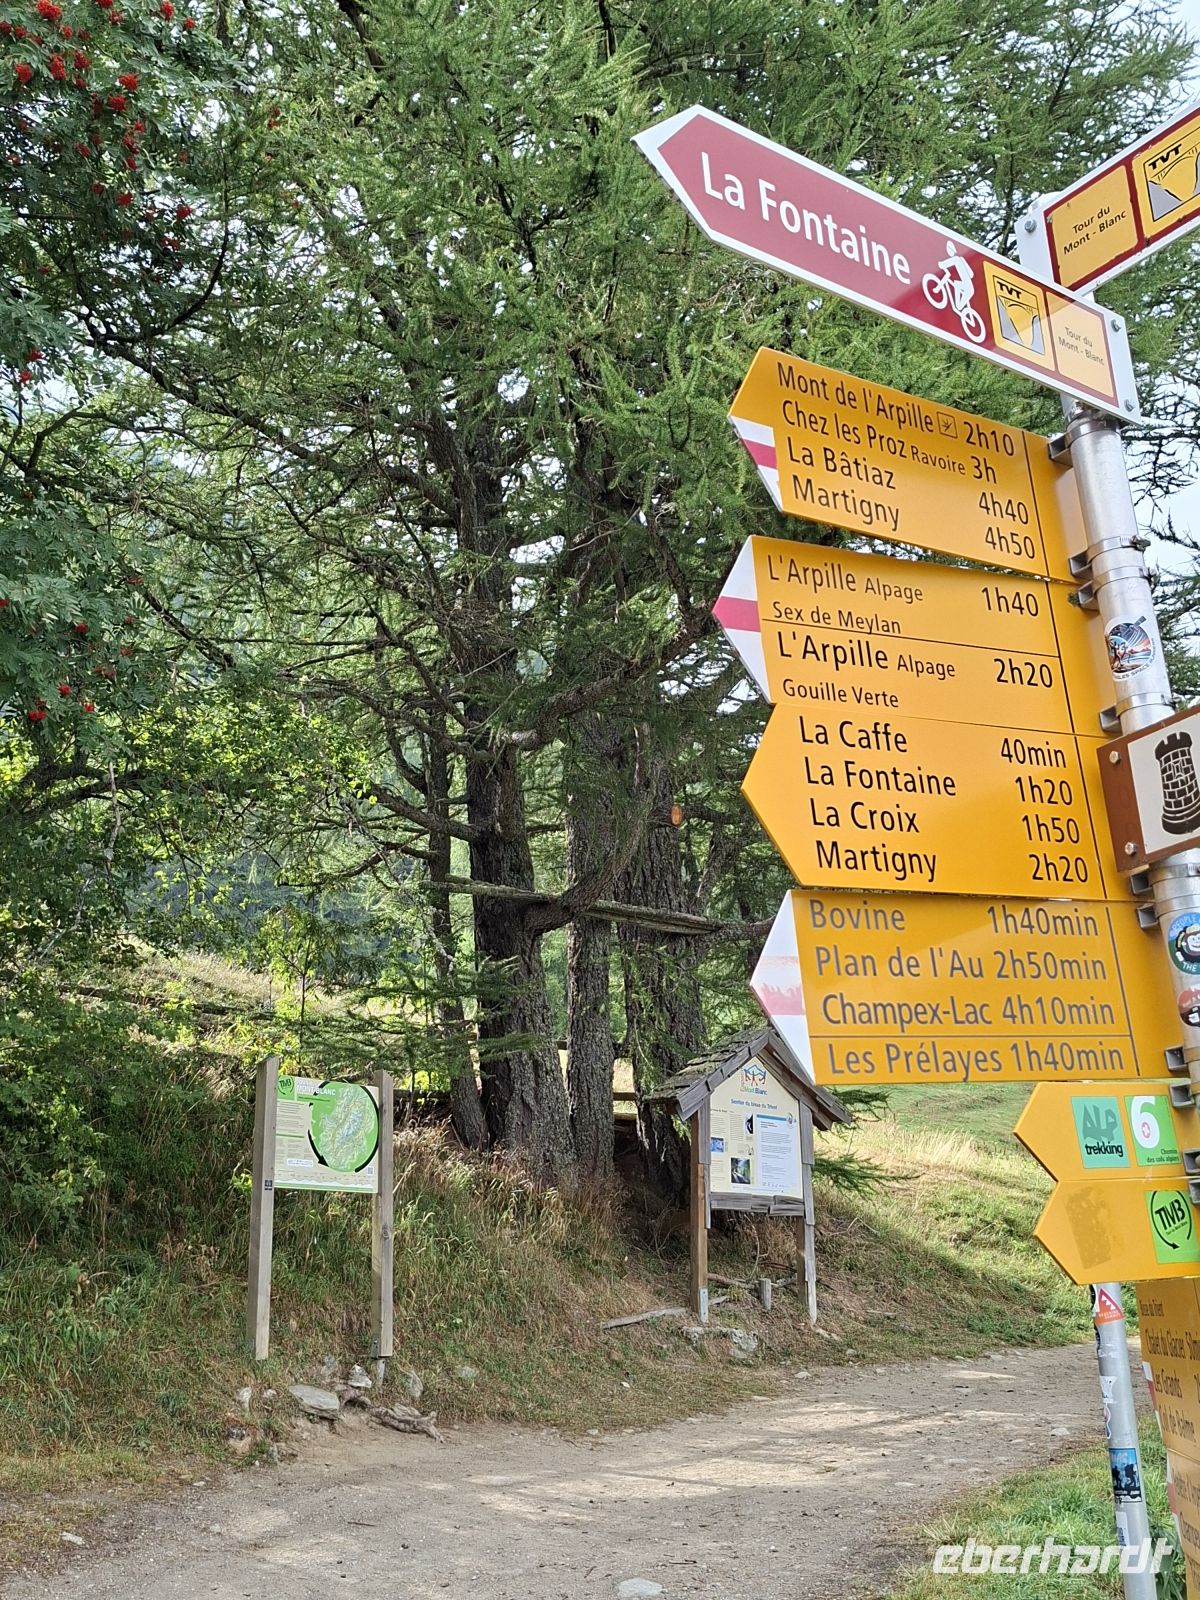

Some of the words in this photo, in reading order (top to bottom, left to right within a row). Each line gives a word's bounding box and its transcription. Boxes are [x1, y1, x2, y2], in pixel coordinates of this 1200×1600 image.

[1148, 143, 1182, 170] TVT
[701, 152, 745, 210] La
[758, 177, 911, 285] Fontaine
[1063, 235, 1090, 255] Mont
[1099, 210, 1126, 232] Blanc
[1072, 216, 1094, 234] Tour
[1097, 206, 1110, 219] du
[997, 281, 1021, 299] TVT
[1058, 336, 1078, 353] Mont
[1085, 350, 1104, 365] Blanc
[1065, 327, 1080, 341] Tour
[1083, 336, 1092, 347] du
[777, 362, 828, 400] Mont
[835, 379, 857, 408] de
[863, 387, 934, 434] l'Arpille
[963, 421, 1014, 456] 2h10
[782, 400, 829, 437] Chez
[835, 413, 861, 444] les
[867, 426, 906, 458] Proz
[911, 444, 966, 475] Ravoire
[971, 456, 997, 484] 3h
[787, 437, 814, 467] La
[824, 443, 895, 489] Bâtiaz
[978, 491, 1029, 525] 4h40
[793, 475, 900, 531] Martigny
[985, 527, 1035, 560] 4h50
[767, 555, 856, 596] L'Arpille
[864, 576, 923, 603] Alpage
[981, 587, 1039, 617] 1h40
[773, 601, 805, 621] Sex
[811, 606, 832, 625] de
[839, 610, 901, 634] Meylan
[777, 632, 889, 673] L'Arpille
[896, 654, 956, 680] Alpage
[996, 659, 1053, 688] 2h20
[783, 678, 848, 703] Gouille
[852, 686, 899, 708] Verte
[799, 716, 829, 744] La
[839, 721, 908, 753] Caffe
[1000, 739, 1067, 768] 40min
[804, 757, 835, 786] La
[845, 760, 957, 796] Fontaine
[1014, 777, 1073, 805] 1h20
[810, 798, 840, 828] La
[850, 801, 920, 833] Croix
[1021, 815, 1080, 844] 1h50
[816, 841, 937, 882] Martigny
[1028, 853, 1089, 883] 2h20
[808, 900, 906, 931] Bovine
[987, 905, 1099, 936] 1h40min
[816, 946, 878, 977] Plan
[888, 950, 921, 978] de
[930, 948, 984, 979] l'Au
[994, 951, 1107, 980] 2h50min
[1183, 962, 1197, 971] THE
[822, 994, 992, 1033] Champex-Lac
[1002, 998, 1115, 1025] 4h10min
[828, 1044, 875, 1074] Les
[887, 1041, 1002, 1082] Prélayes
[1011, 1042, 1124, 1071] 1h40min
[1131, 1096, 1160, 1148] 6
[1085, 1142, 1124, 1157] trekking
[1155, 1198, 1185, 1231] TMB
